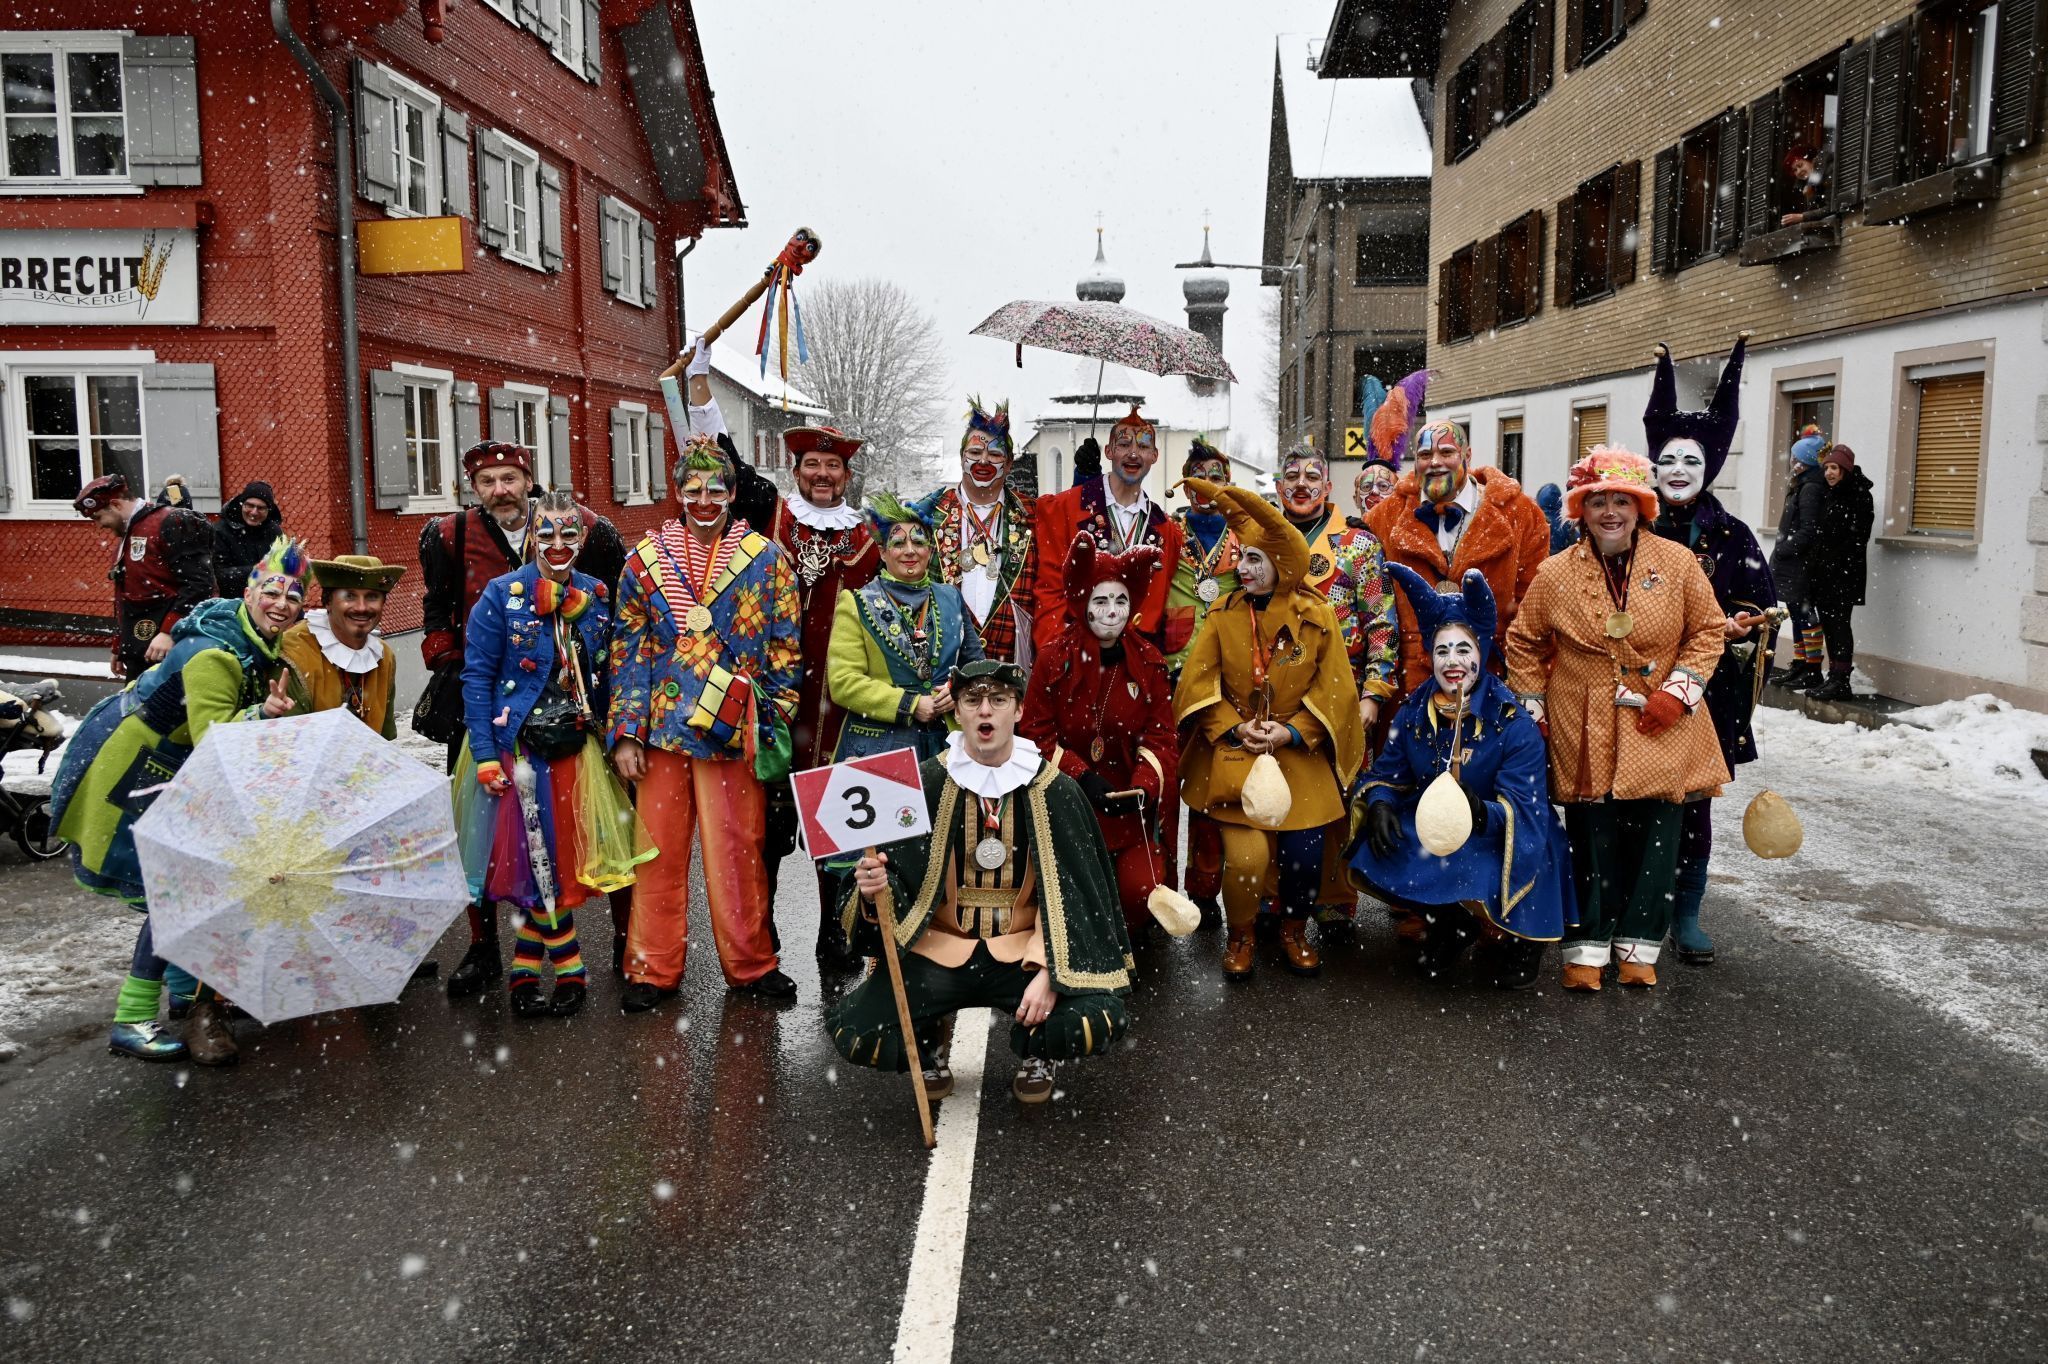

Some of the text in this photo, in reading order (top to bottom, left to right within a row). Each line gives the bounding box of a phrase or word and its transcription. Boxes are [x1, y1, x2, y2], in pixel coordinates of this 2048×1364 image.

[1, 256, 144, 295] BRECHT
[33, 290, 133, 306] BÄCKEREI
[841, 785, 877, 830] 3
